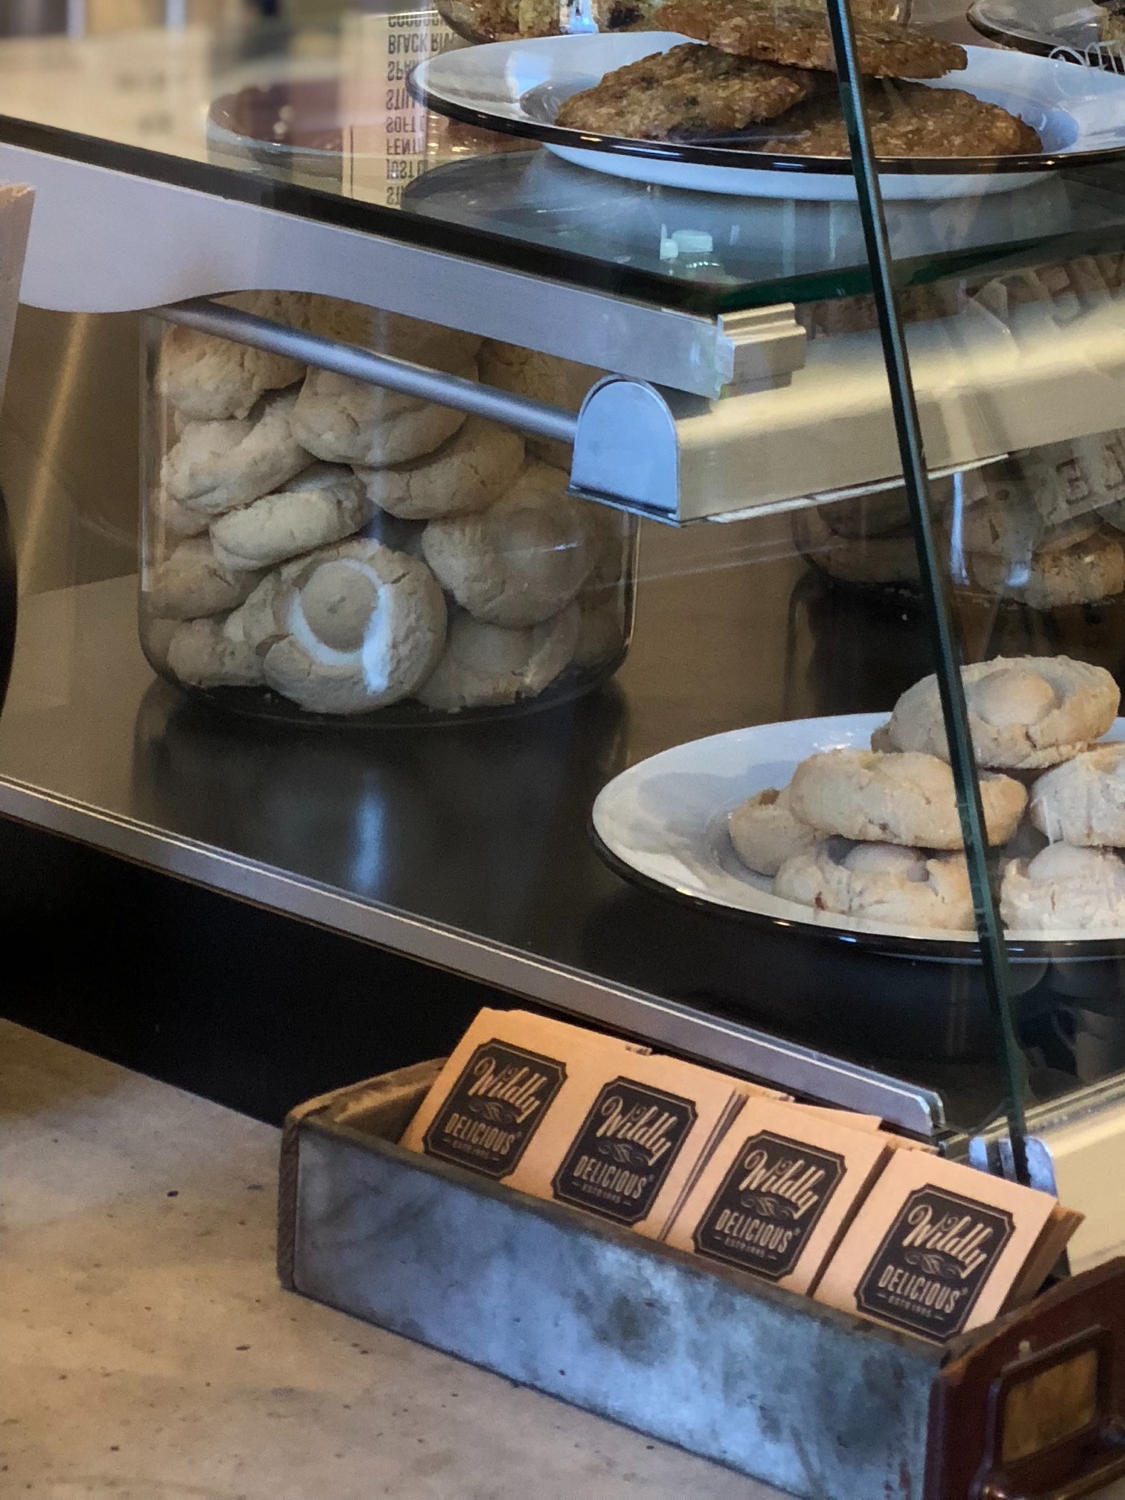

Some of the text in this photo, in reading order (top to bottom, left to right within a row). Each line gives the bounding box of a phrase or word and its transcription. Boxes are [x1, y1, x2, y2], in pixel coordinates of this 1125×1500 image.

[467, 1057, 548, 1124] Wildly
[444, 1113, 516, 1156] DELICIOUS
[595, 1095, 678, 1167] Wildly
[572, 1155, 648, 1199] DELICIOUS
[738, 1149, 826, 1220] Wildly
[715, 1208, 793, 1254] DELICIOUS
[902, 1204, 994, 1280] Wildly
[878, 1264, 960, 1314] DELICIOUS
